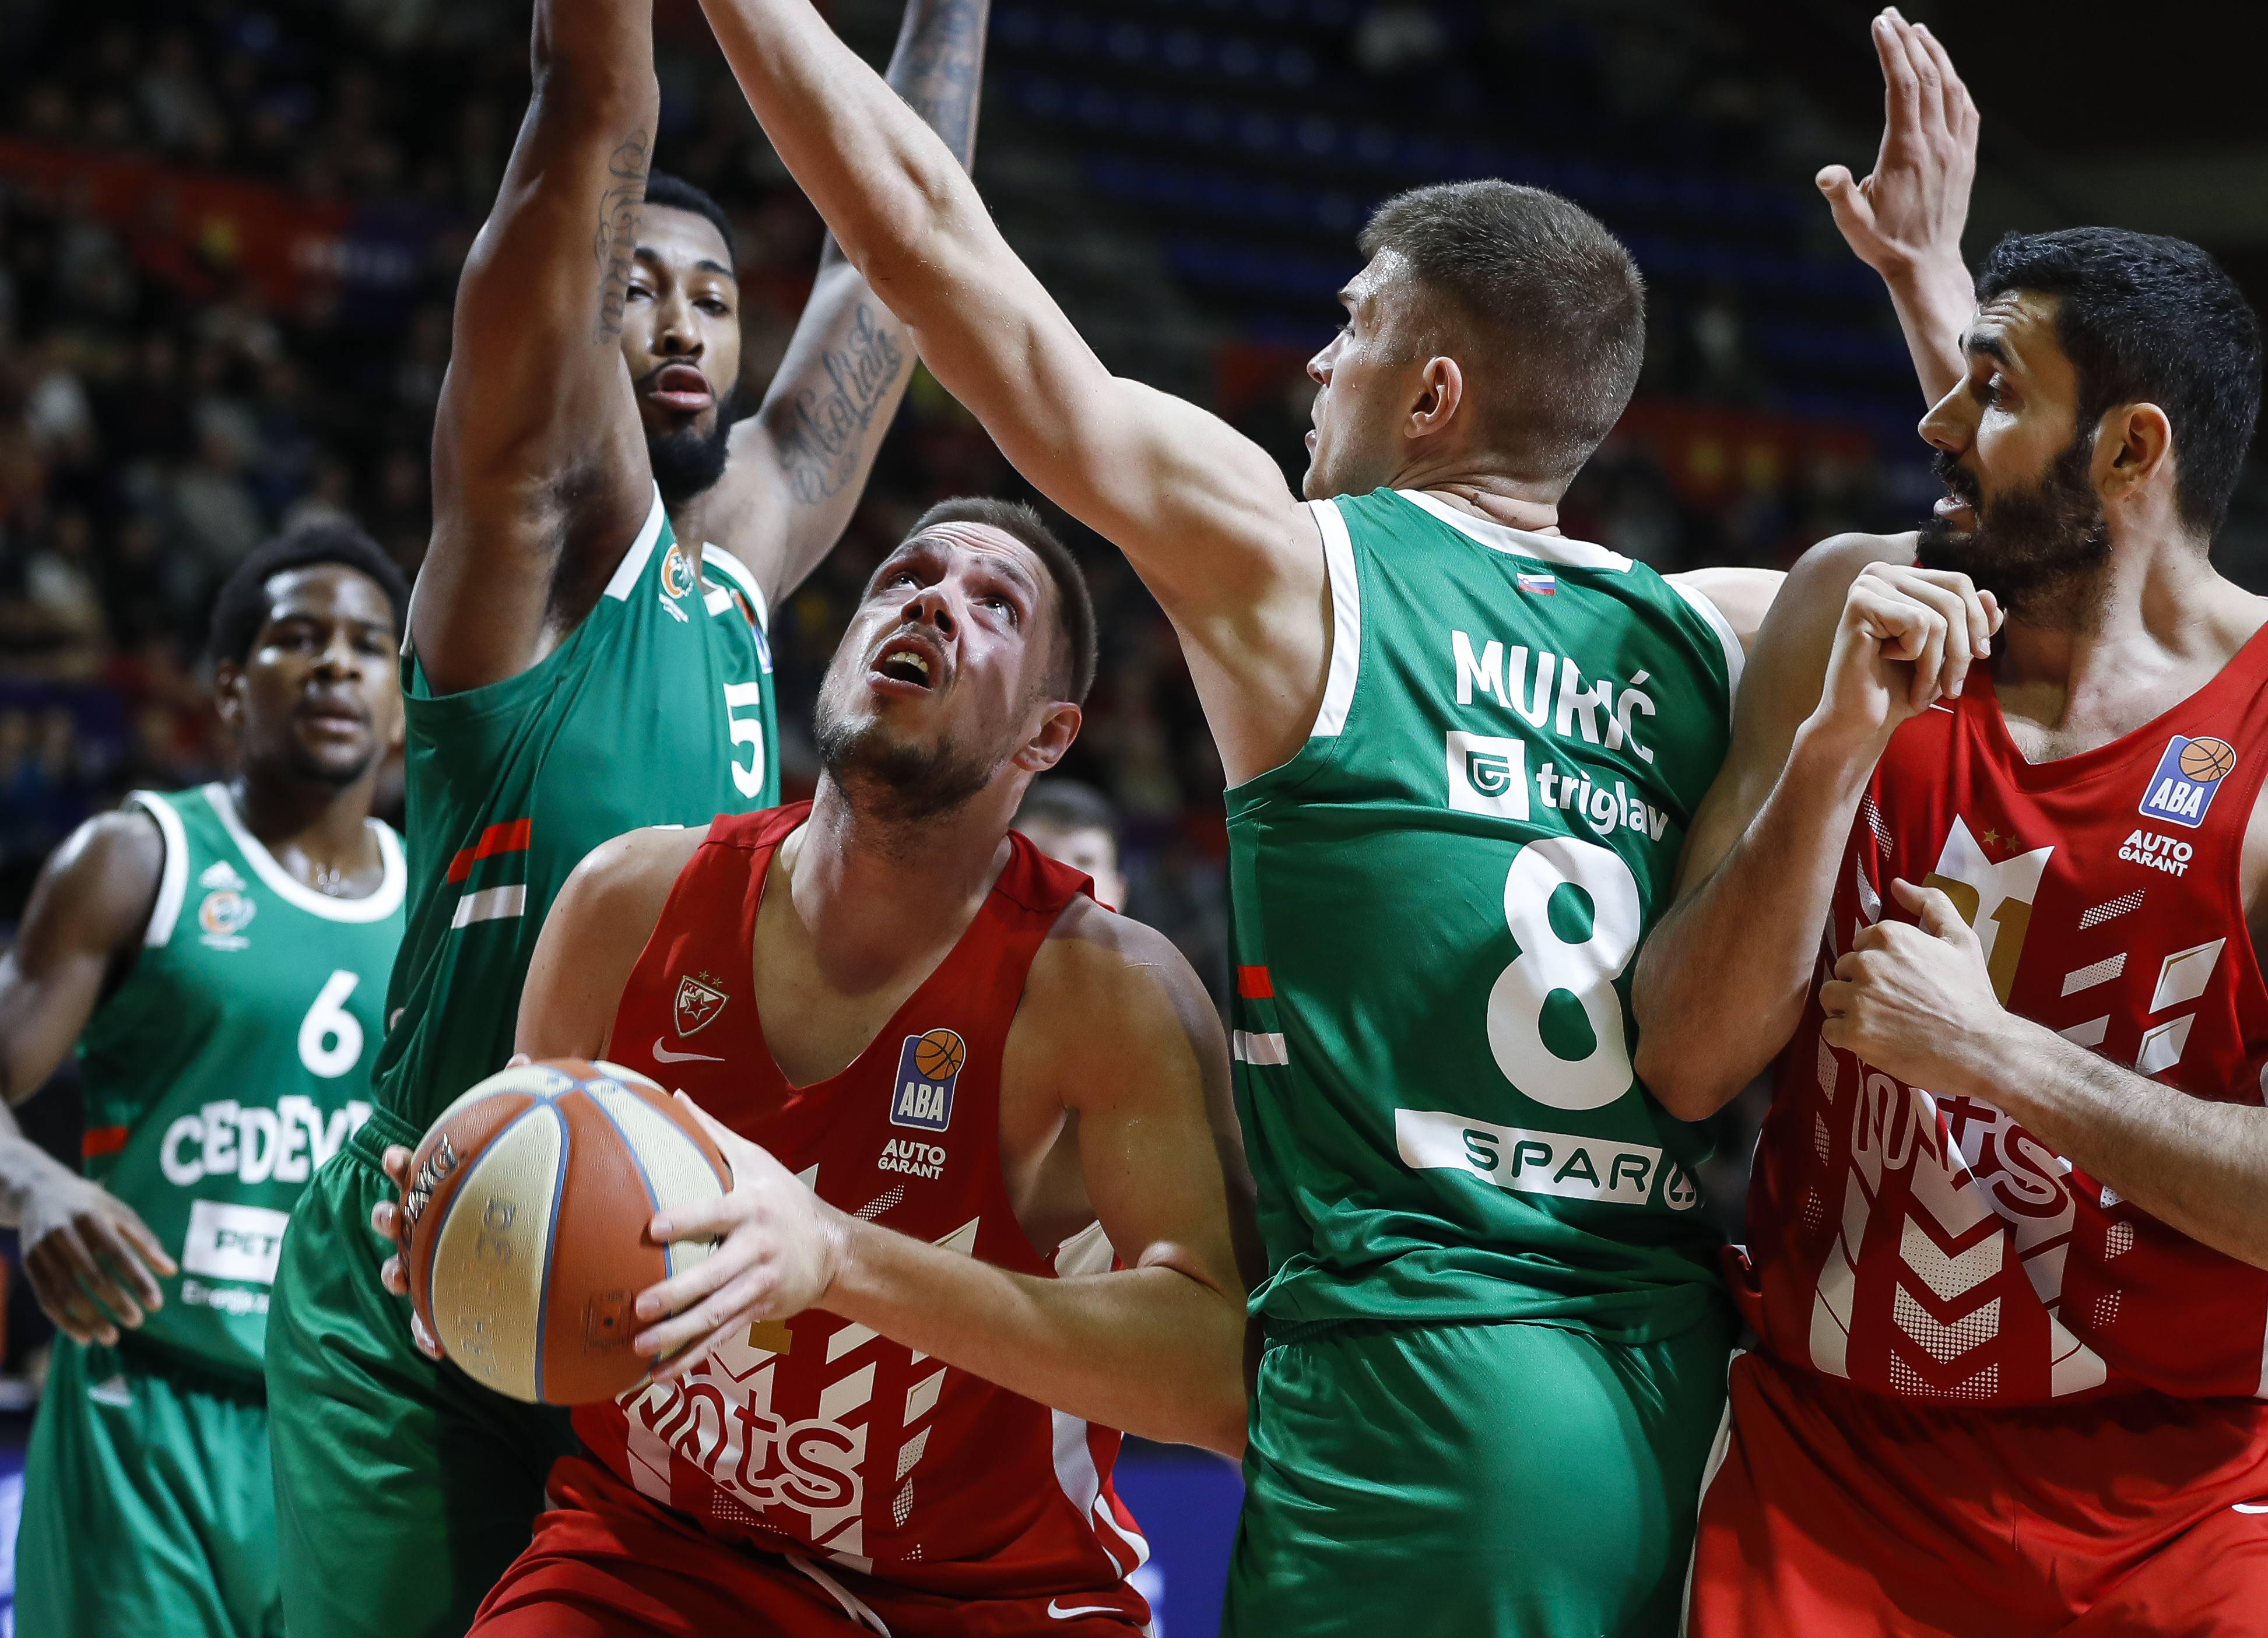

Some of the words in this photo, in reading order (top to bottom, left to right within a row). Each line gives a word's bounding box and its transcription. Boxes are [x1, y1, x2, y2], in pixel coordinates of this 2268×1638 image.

[1452, 629, 1656, 765] MURIĆ
[724, 681, 765, 799] 5
[1536, 762, 1669, 842] triglav
[2148, 777, 2205, 819] ABA
[2118, 846, 2188, 877] GARANT
[2123, 829, 2193, 862] AUTO
[1487, 836, 1641, 1110] 8
[297, 969, 364, 1079] 6
[898, 1081, 944, 1122] ABA
[877, 1157, 943, 1180] GARANT
[882, 1138, 946, 1165] AUTO
[1462, 1128, 1652, 1193] SPAR
